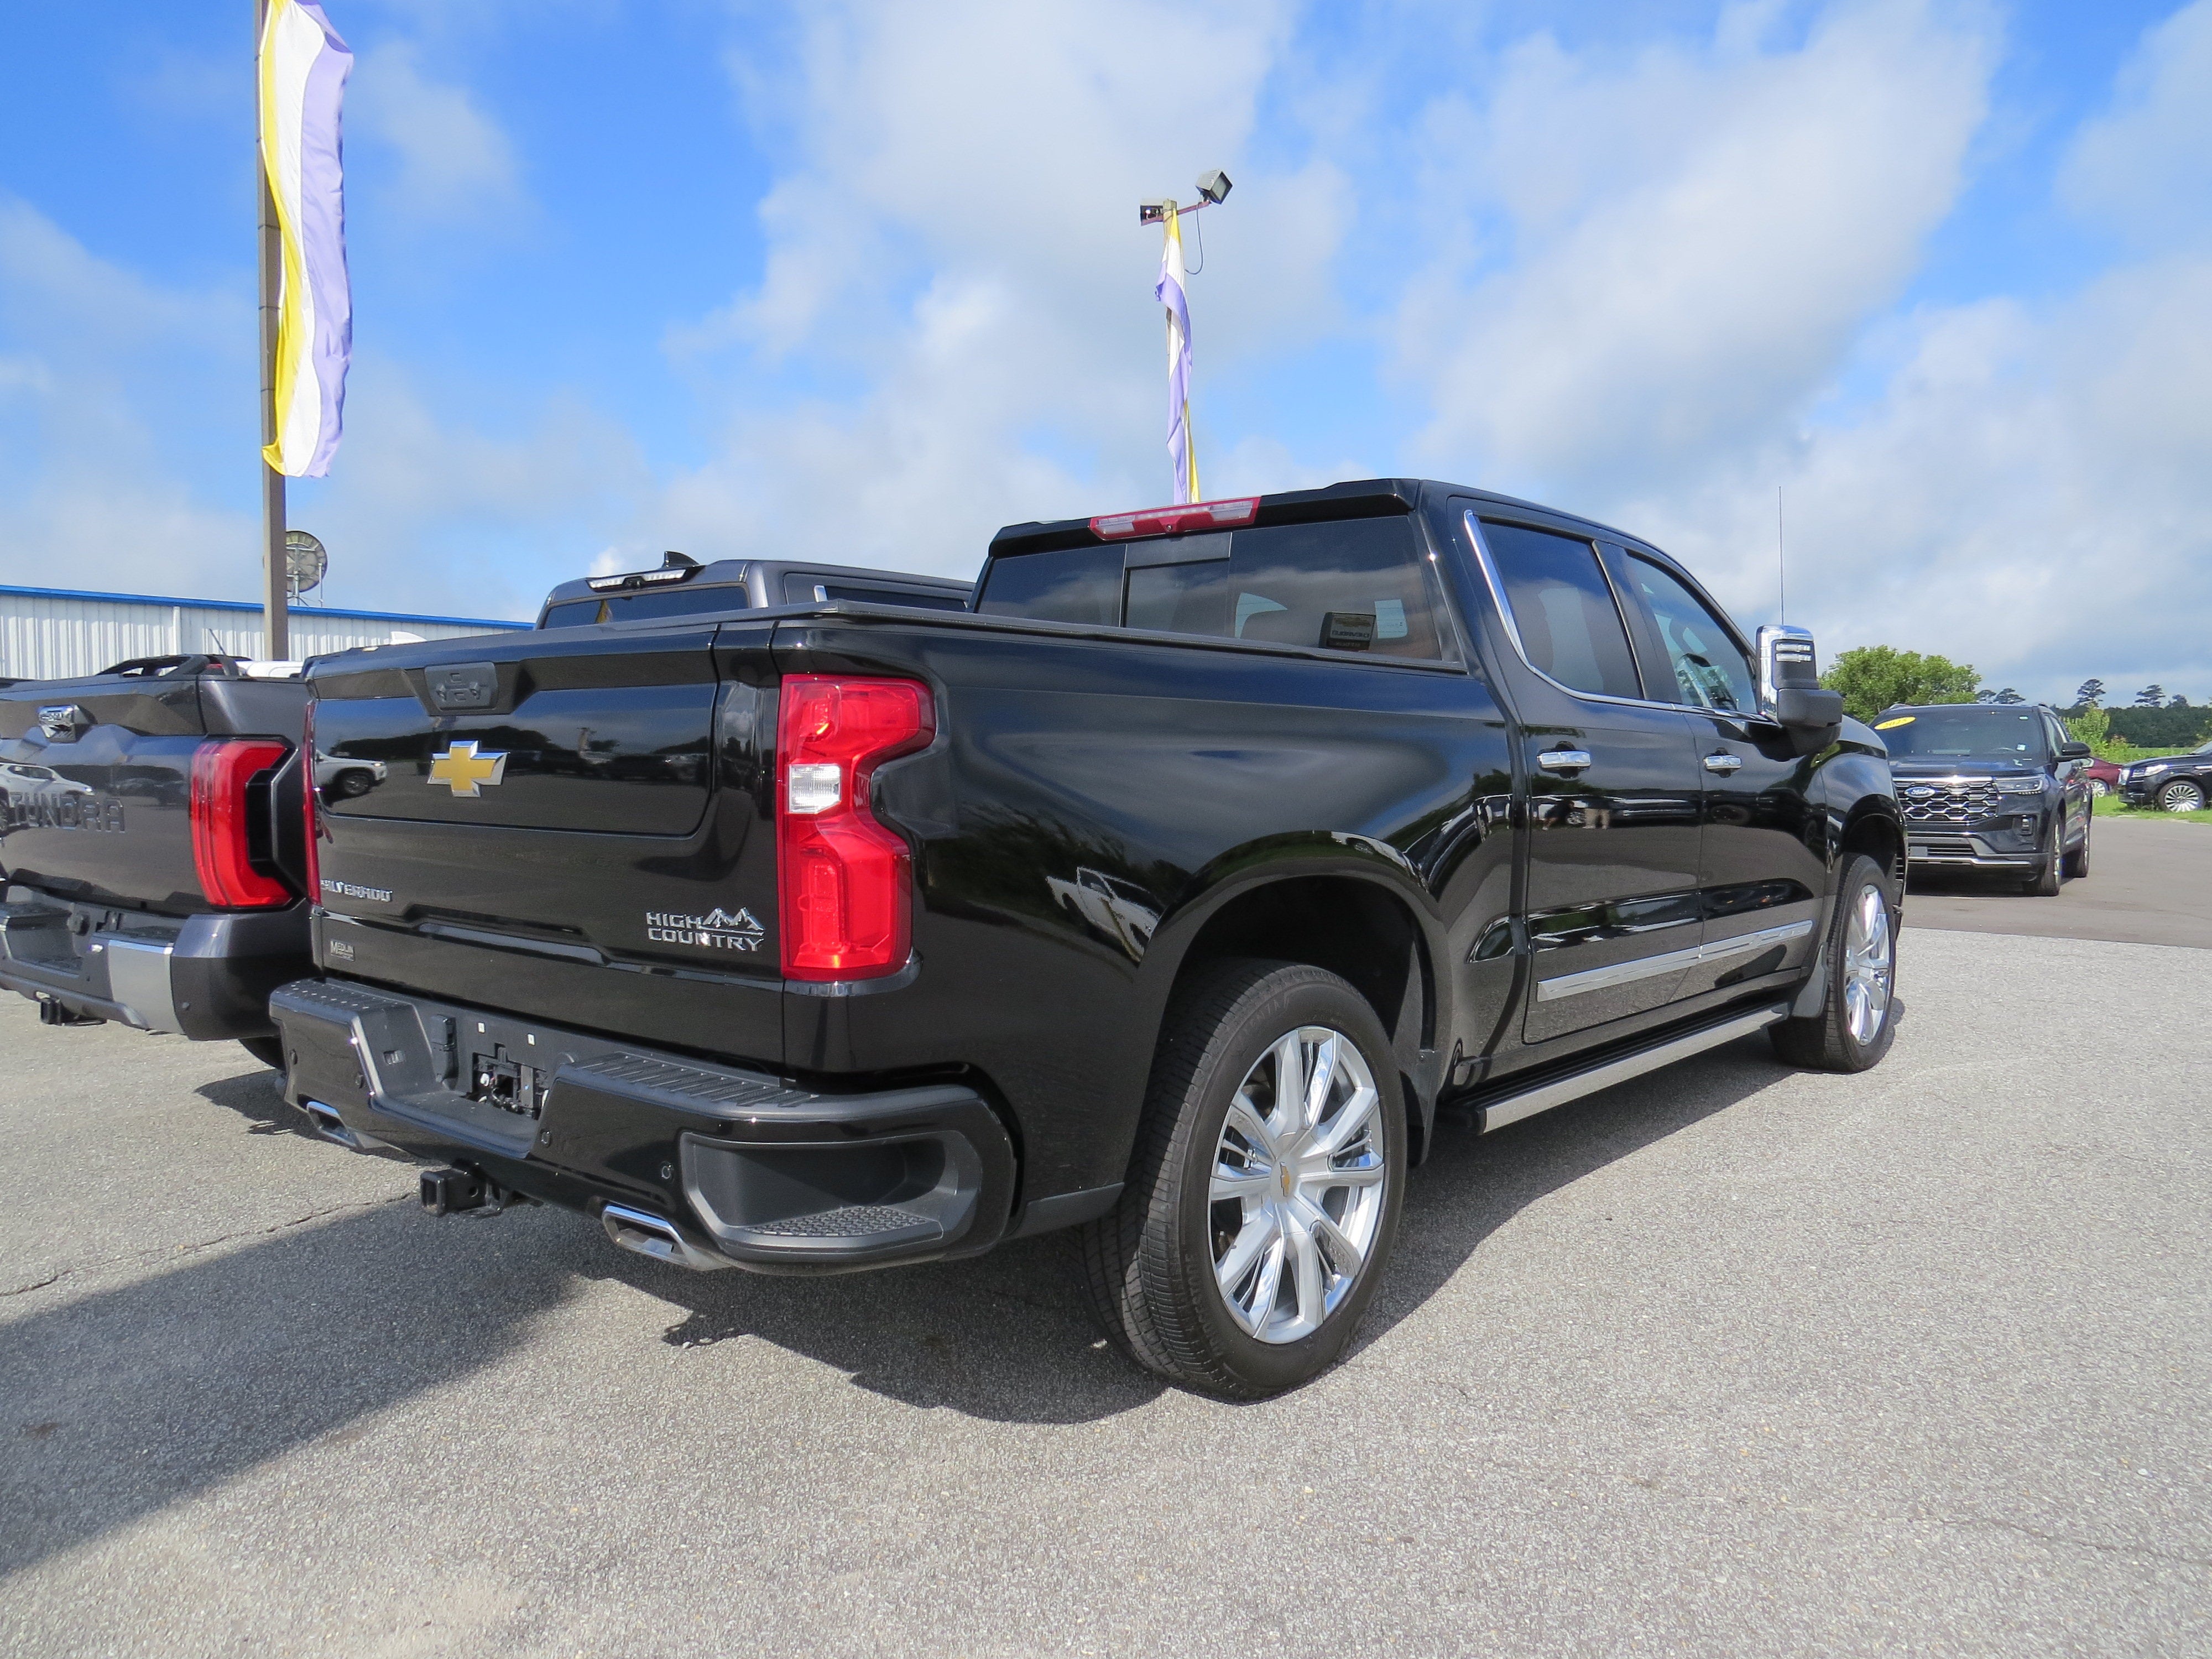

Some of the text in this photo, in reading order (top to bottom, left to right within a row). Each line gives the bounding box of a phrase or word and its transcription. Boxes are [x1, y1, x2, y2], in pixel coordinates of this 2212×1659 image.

[8, 791, 126, 833] TUNDRA
[320, 879, 393, 902] SILVERADO
[646, 911, 703, 930] HIGH
[648, 927, 764, 952] COUNTRY
